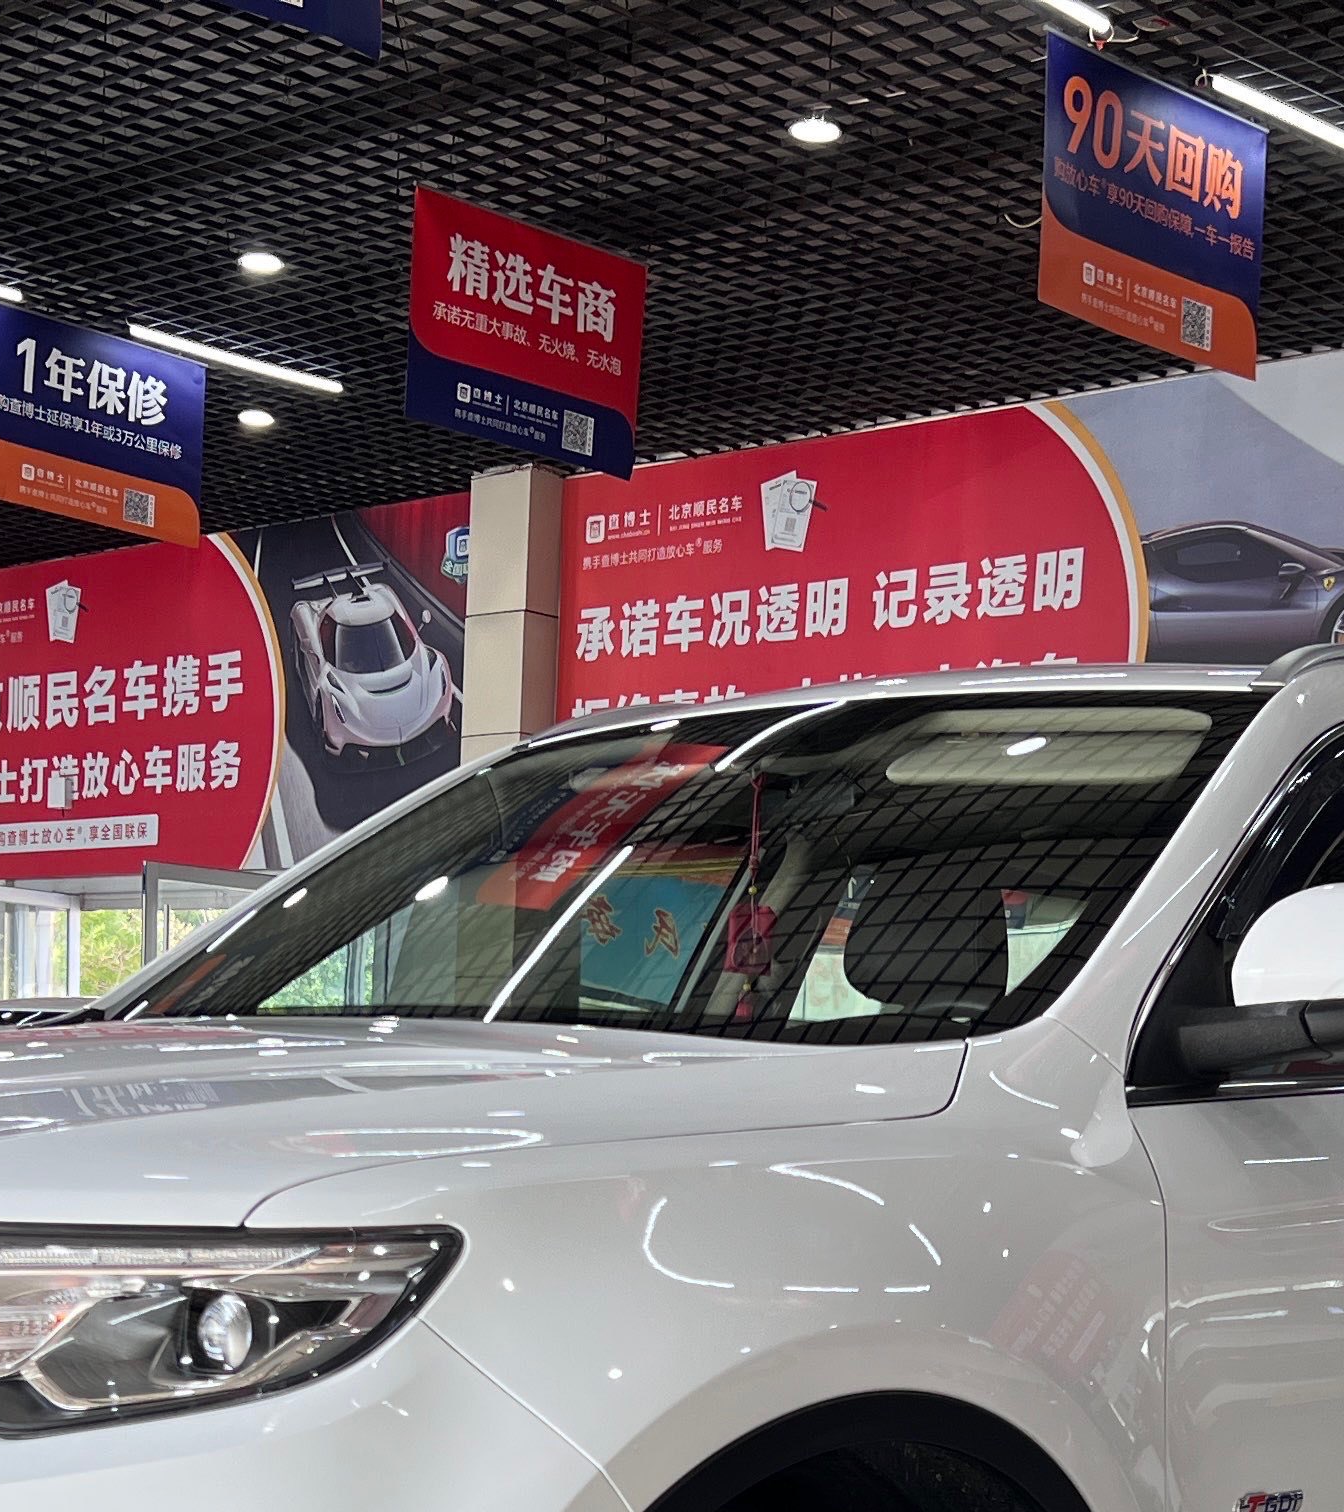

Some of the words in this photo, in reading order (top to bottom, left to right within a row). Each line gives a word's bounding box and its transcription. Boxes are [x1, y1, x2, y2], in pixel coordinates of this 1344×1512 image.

[1063, 75, 1243, 220] 90天回购
[447, 232, 617, 343] 精选车商
[16, 337, 168, 426] 1年保修
[513, 399, 559, 421] 北京顺民名车
[609, 509, 651, 530] 查博士
[669, 495, 743, 521] 北京顺民名车
[576, 578, 849, 662] 承诺车况透明
[873, 546, 1085, 631] 记录透明
